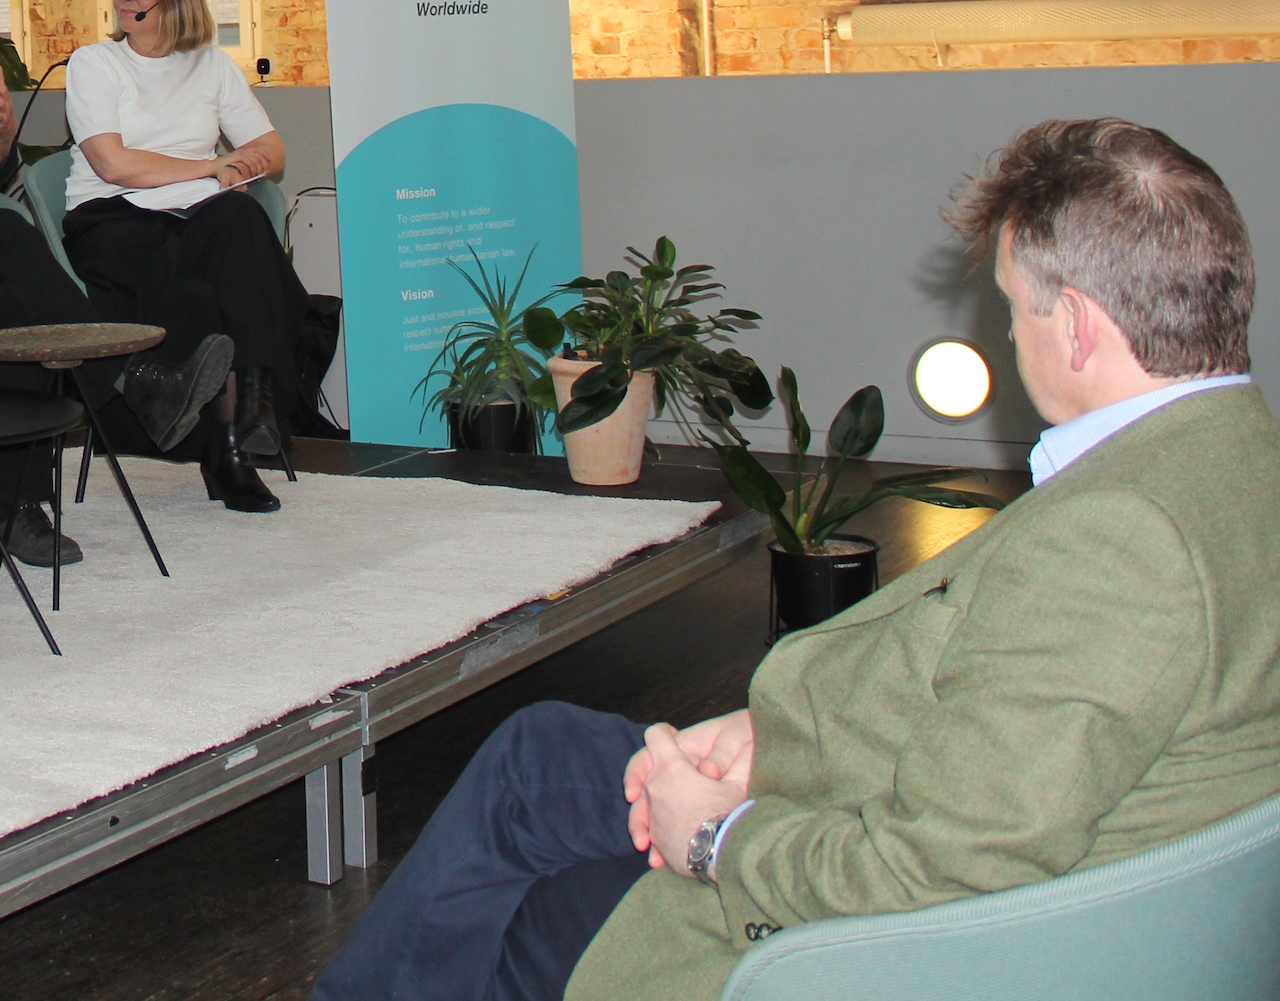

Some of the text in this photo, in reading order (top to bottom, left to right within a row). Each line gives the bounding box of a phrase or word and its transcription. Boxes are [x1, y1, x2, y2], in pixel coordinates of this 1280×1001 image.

[416, 0, 489, 17] Worldwide
[396, 187, 436, 200] Mission
[397, 206, 491, 224] To contribute to a wider
[397, 225, 454, 239] understanding
[467, 221, 484, 231] and
[485, 219, 516, 230] respect
[415, 241, 442, 252] human
[443, 239, 465, 250] rights
[399, 254, 447, 269] international
[449, 249, 500, 263] humantarian
[401, 289, 434, 302] Vision
[402, 315, 419, 325] Just
[421, 313, 436, 323] and
[403, 326, 432, 339] respect
